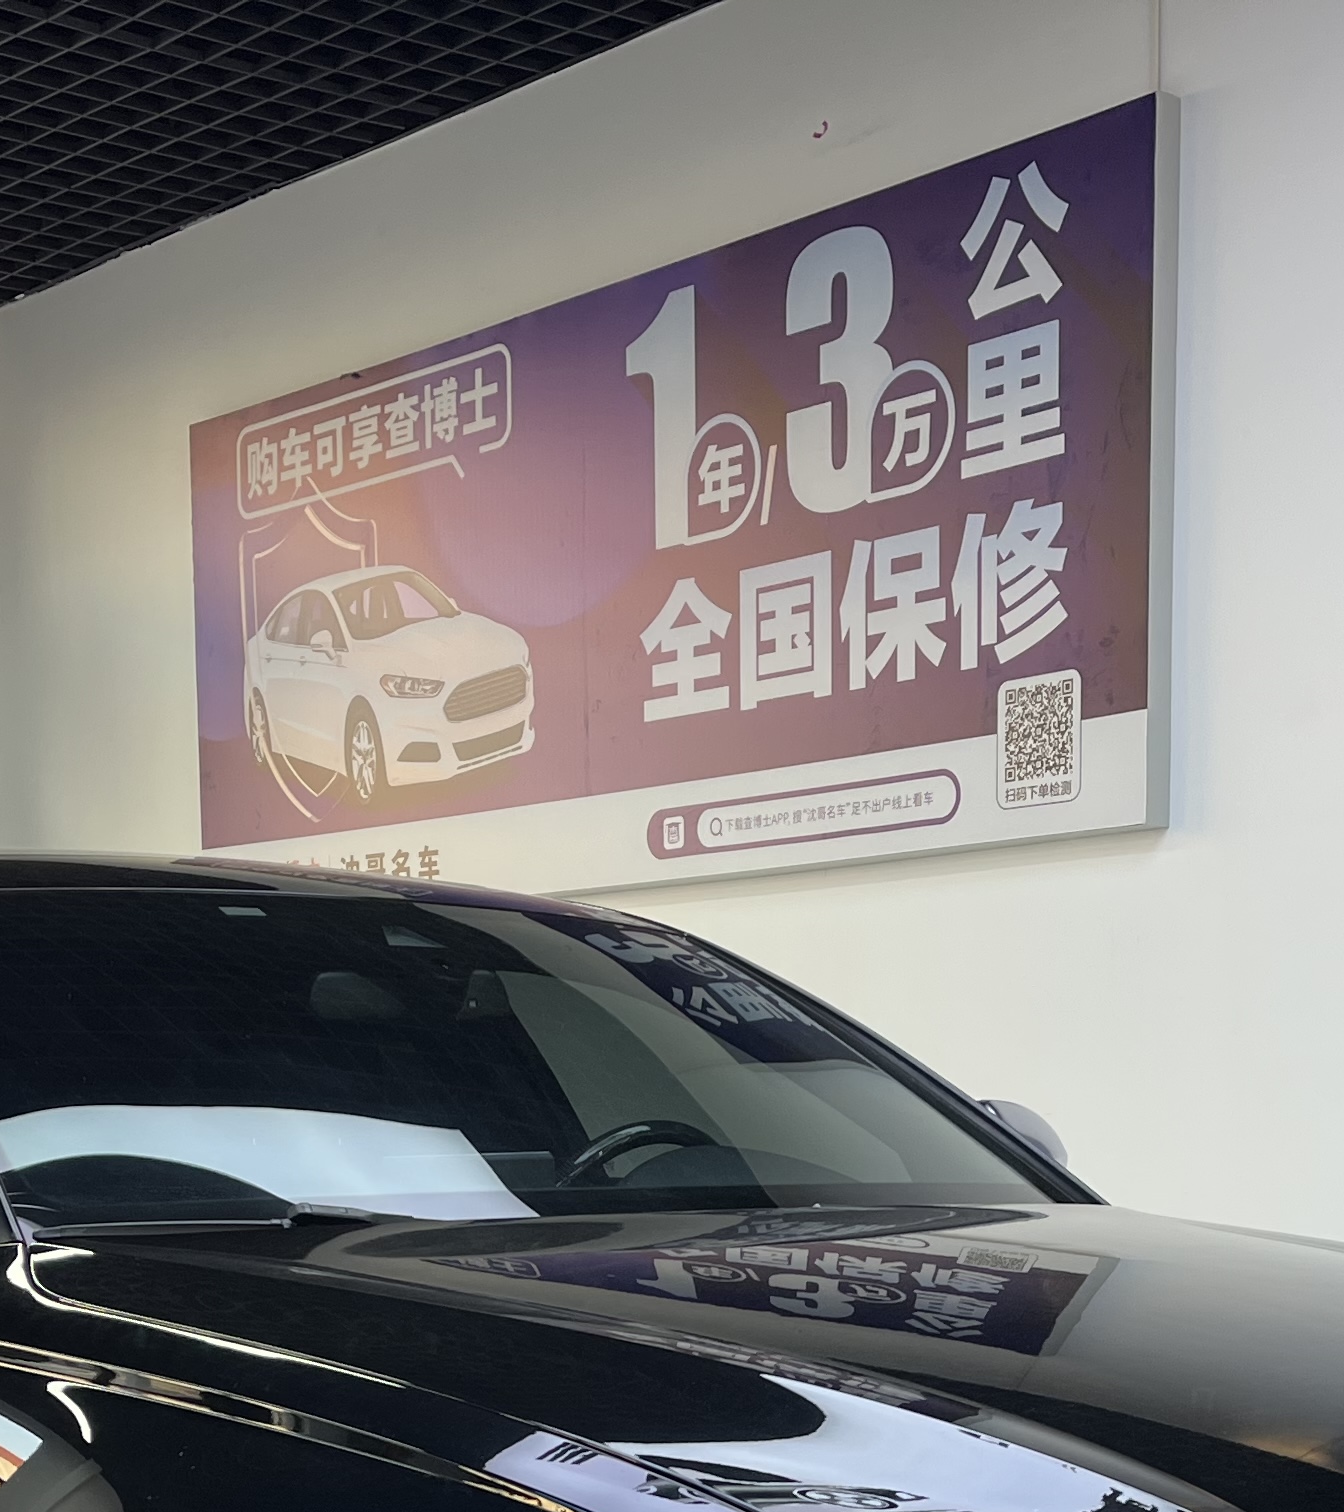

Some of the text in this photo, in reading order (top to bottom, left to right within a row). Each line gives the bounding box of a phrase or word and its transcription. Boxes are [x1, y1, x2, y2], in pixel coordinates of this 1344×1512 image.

[245, 366, 500, 499] 购车可享查博士
[640, 498, 1069, 722] 全国保修
[1005, 780, 1072, 803] 扫码下单检测
